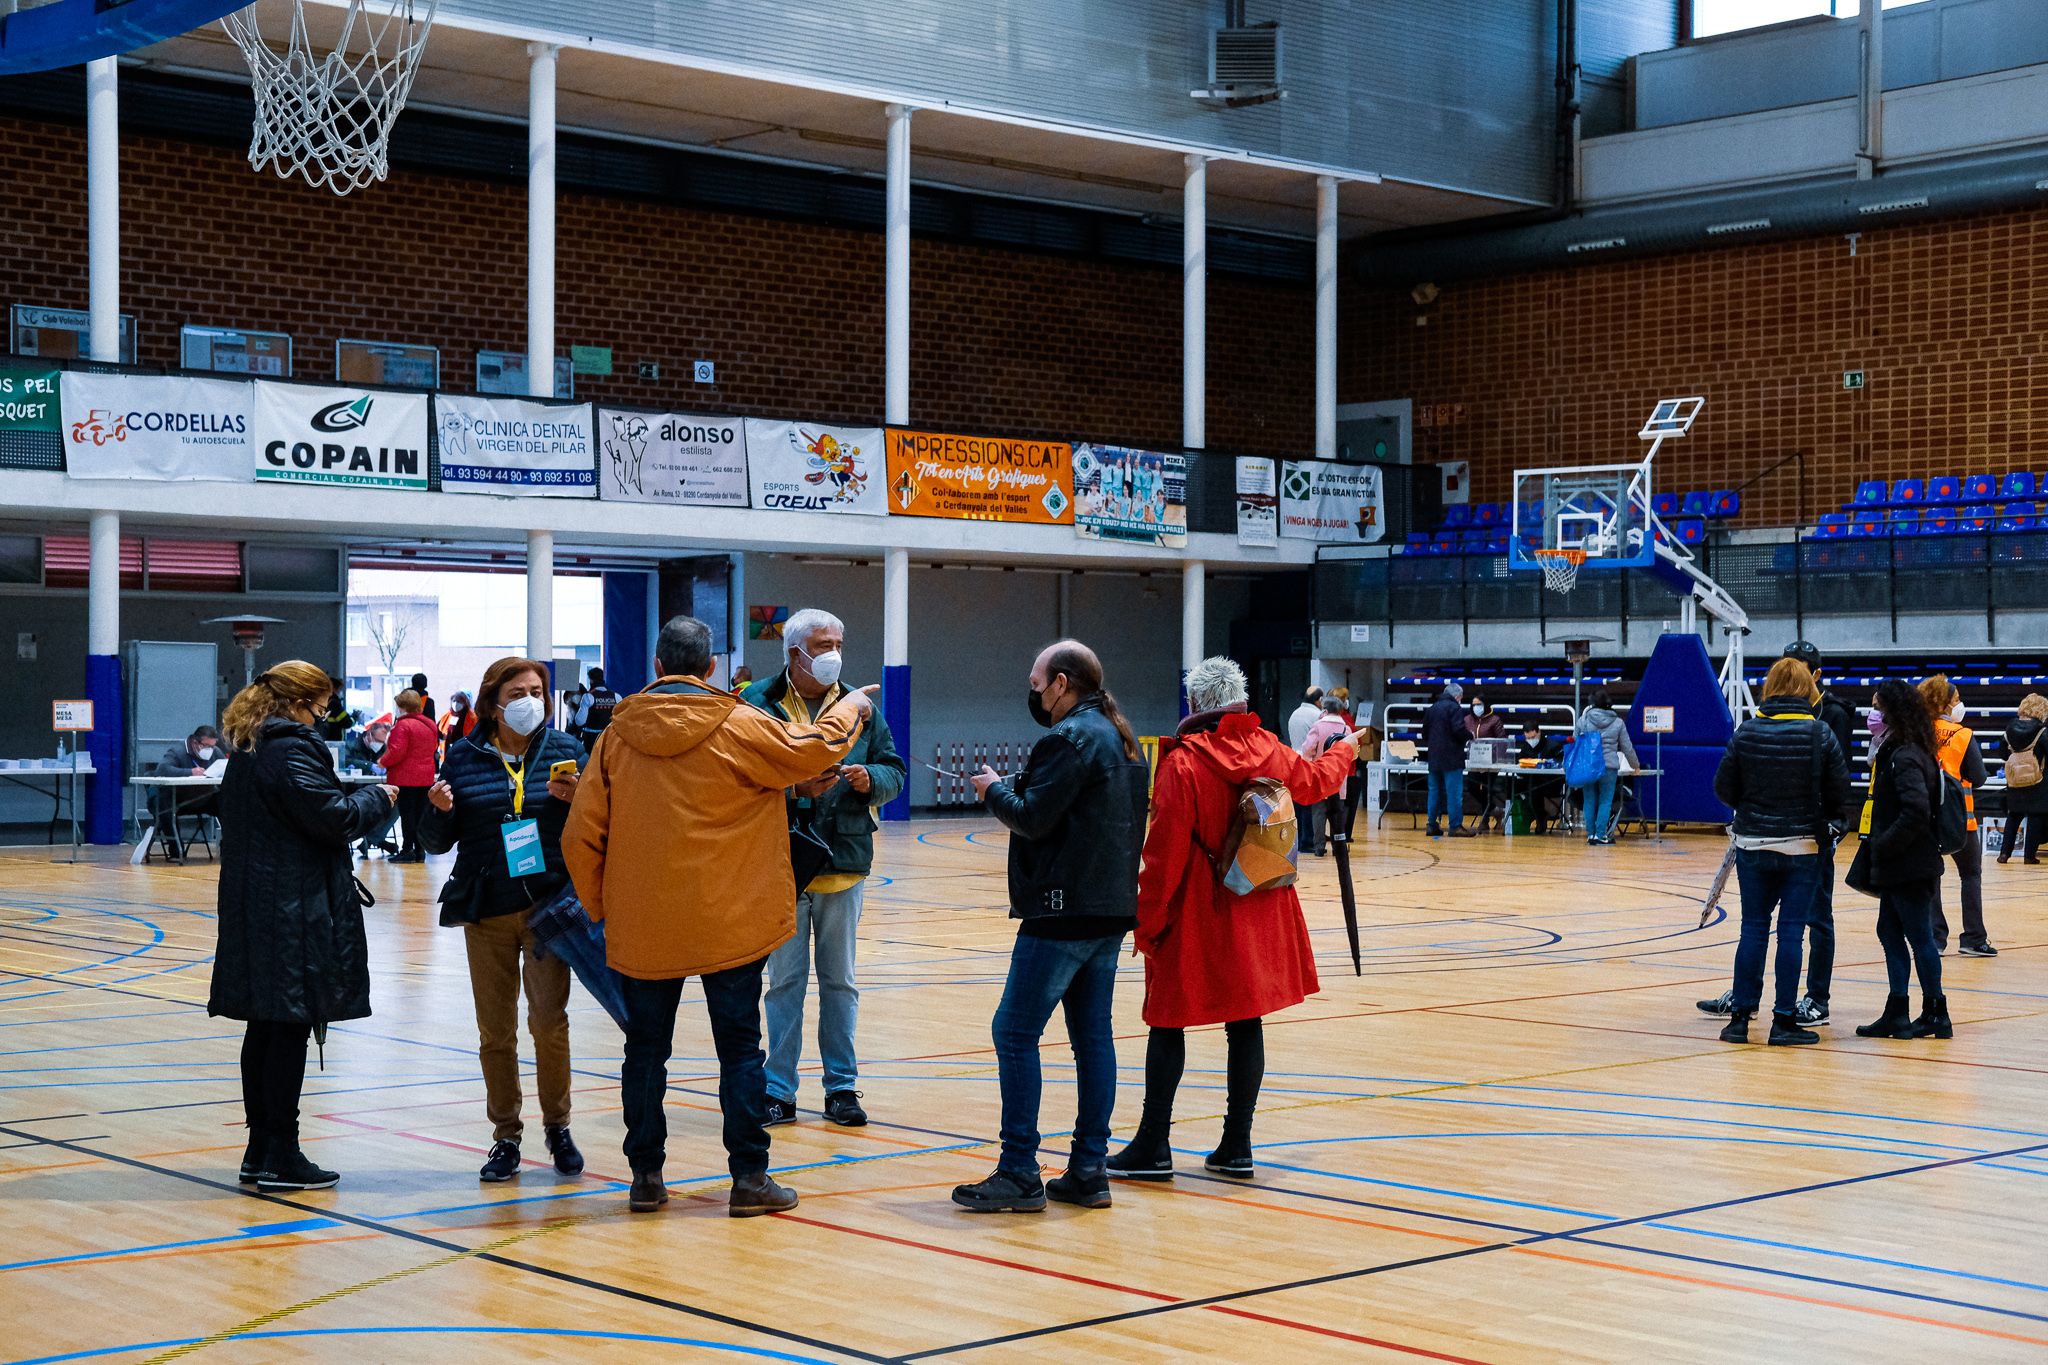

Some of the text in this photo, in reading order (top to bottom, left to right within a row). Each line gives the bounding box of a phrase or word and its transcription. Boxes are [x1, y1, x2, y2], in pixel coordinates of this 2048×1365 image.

[24, 378, 54, 393] PEL
[126, 411, 246, 434] CORDELLAS
[474, 420, 586, 439] CLINICA DENTAL
[660, 419, 734, 444] alonso
[182, 436, 246, 445] TU AUTOESCUELA
[476, 438, 586, 454] VIRGEN DEL PILAR
[265, 440, 418, 475] COPAIN
[680, 446, 712, 456] estilista
[896, 434, 1063, 469] IMPRESSIONS.CAT
[275, 471, 335, 482] COMERCIAL
[341, 474, 383, 486] COPAIN,
[458, 467, 471, 479] 93
[473, 469, 492, 480] 594
[495, 470, 508, 480] 44
[510, 470, 522, 482] 90
[530, 472, 543, 482] 93
[544, 472, 563, 483] 692
[565, 472, 575, 483] 51
[578, 472, 592, 483] 08
[915, 461, 941, 481] Tot
[939, 467, 954, 479] en
[955, 465, 985, 488] Arts
[763, 482, 800, 491] ESPORTS
[1332, 487, 1351, 497] GRAN
[764, 494, 836, 510] CREUS
[982, 491, 999, 500] amb
[935, 501, 941, 509] a
[943, 500, 987, 512] Cerdanyola
[990, 503, 1003, 513] del
[1323, 519, 1328, 527] A
